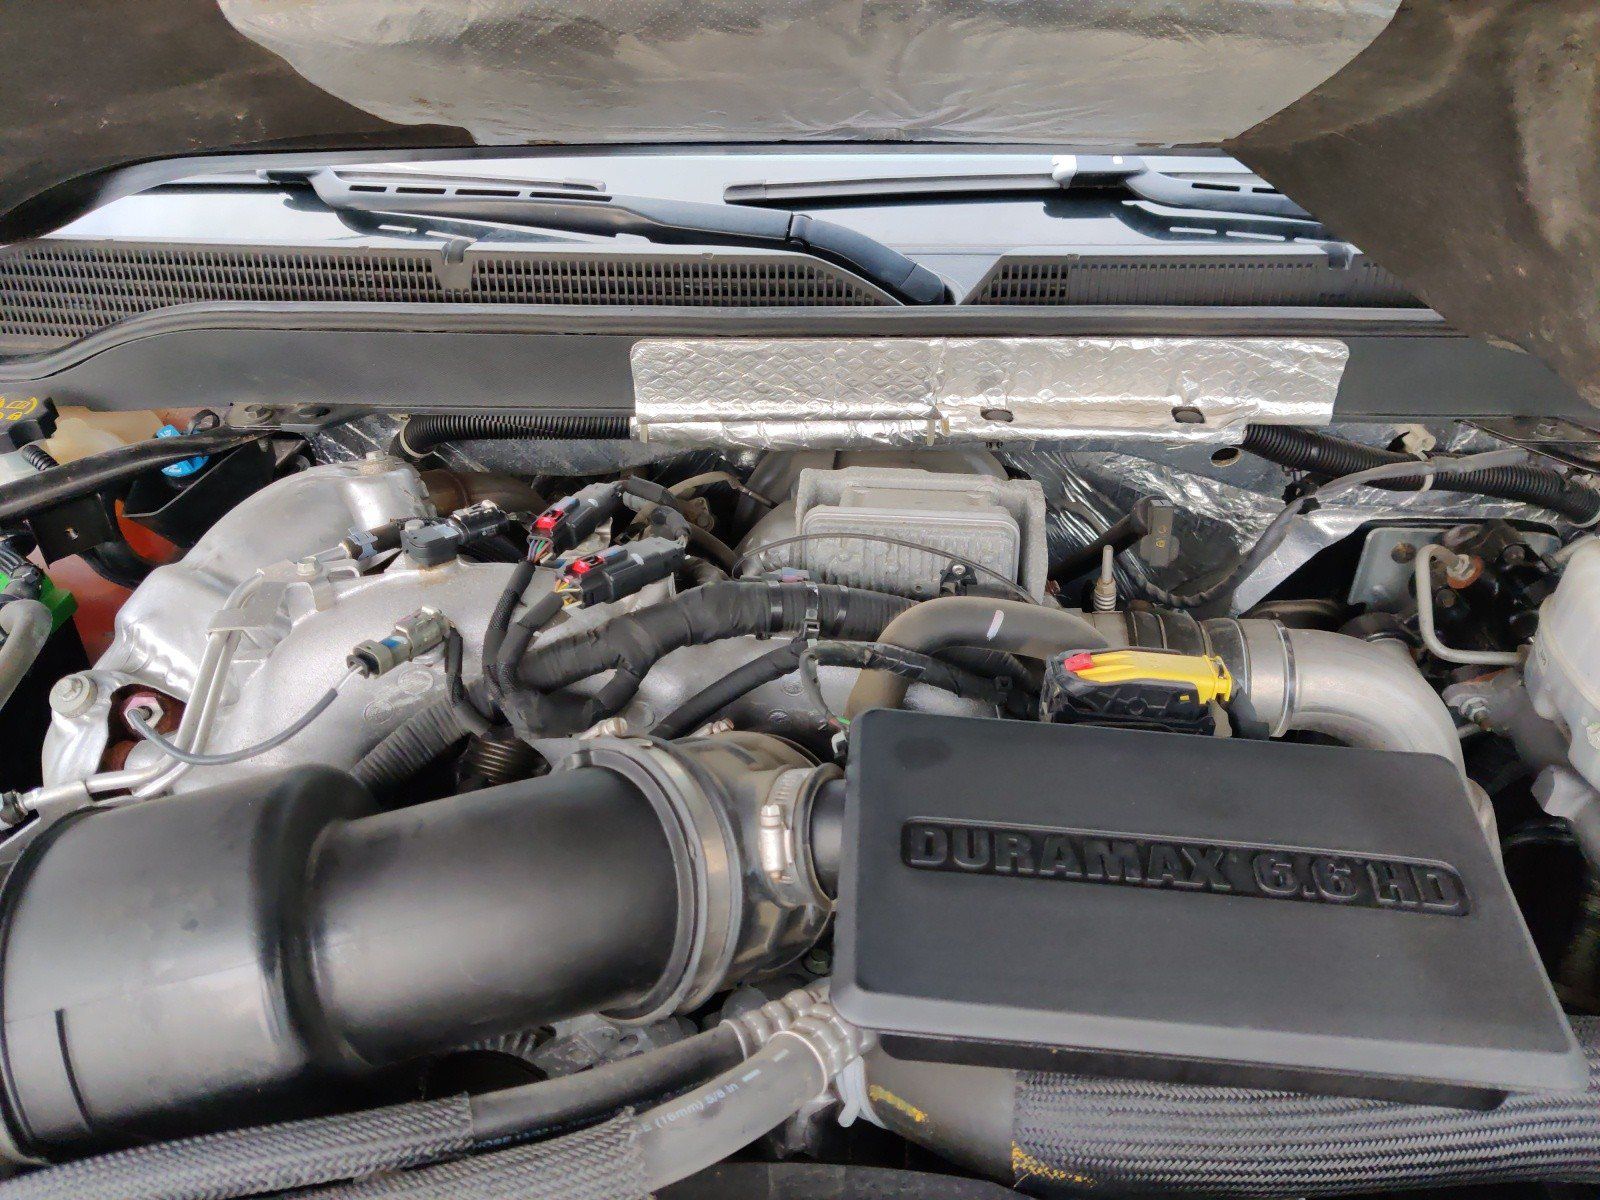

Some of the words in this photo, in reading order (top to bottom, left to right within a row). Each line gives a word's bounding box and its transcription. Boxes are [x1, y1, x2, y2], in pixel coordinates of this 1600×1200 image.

[910, 827, 1232, 891] DURAMAX
[1253, 851, 1360, 900] 6.6
[1366, 860, 1463, 909] HD
[655, 1100, 704, 1128] (16mm)
